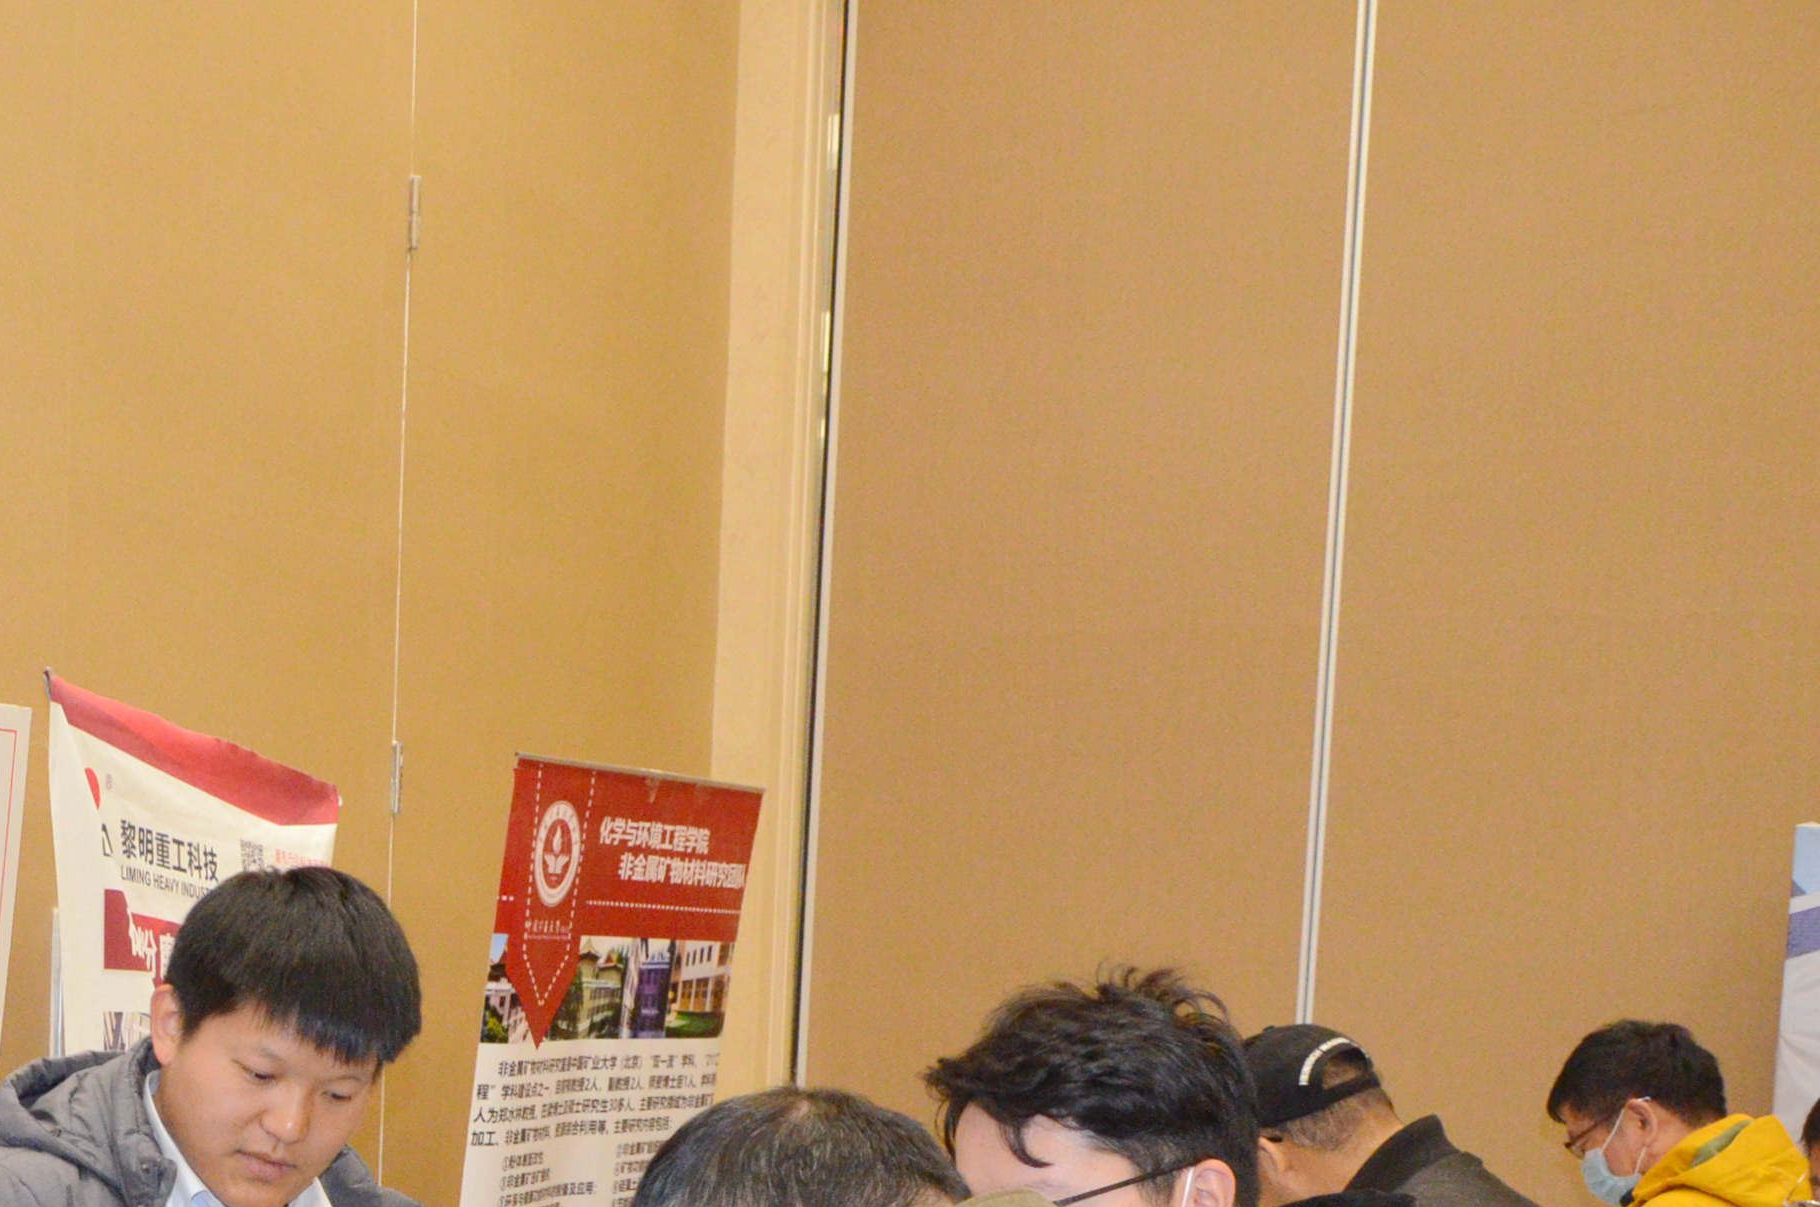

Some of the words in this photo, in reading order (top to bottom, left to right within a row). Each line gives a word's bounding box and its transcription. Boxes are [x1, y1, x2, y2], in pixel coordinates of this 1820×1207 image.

[120, 818, 219, 883] 黎明重工科技
[599, 815, 711, 855] 化学与环境工程学院
[121, 864, 152, 887] LIMING
[153, 872, 180, 894] HEAVY
[181, 880, 214, 900] INDUS
